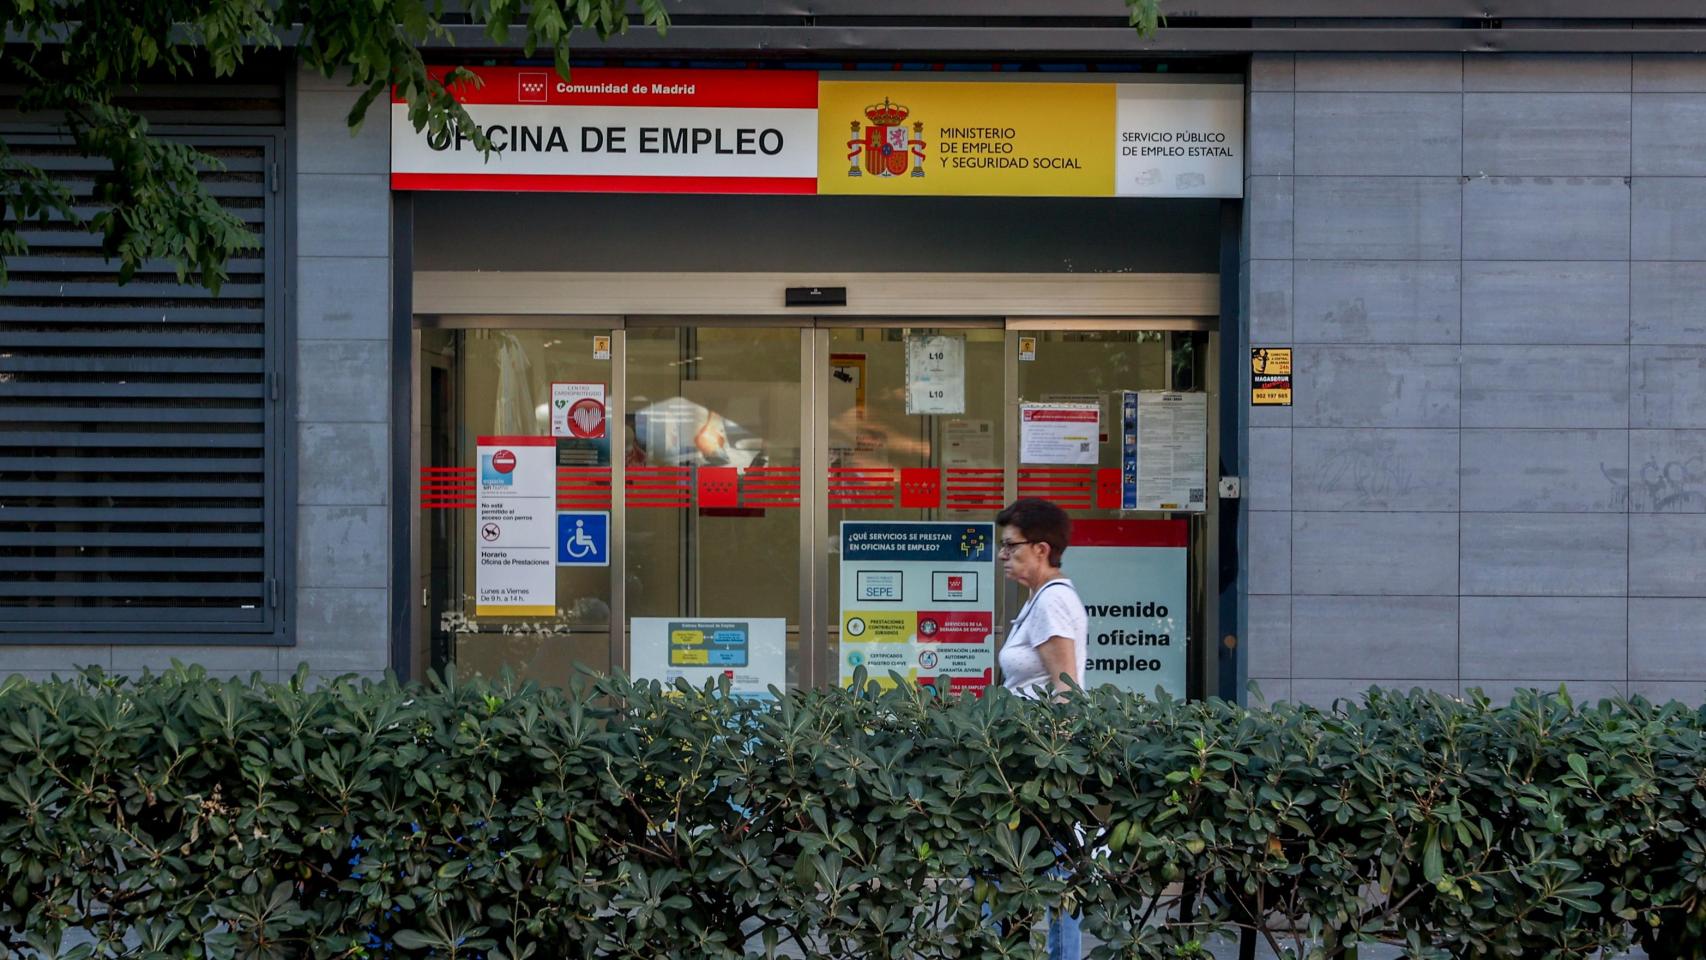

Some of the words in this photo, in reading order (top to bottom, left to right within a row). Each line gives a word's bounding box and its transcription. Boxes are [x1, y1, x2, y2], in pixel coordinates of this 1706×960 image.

[556, 82, 628, 94] Comunidad
[632, 84, 648, 94] de
[652, 84, 696, 95] Madrid
[940, 128, 1016, 139] MINISTERIO
[1122, 132, 1173, 142] SERVICIO
[1176, 130, 1226, 142] PÚBLICO
[426, 124, 568, 152] OFCINA
[581, 126, 626, 154] DE
[639, 127, 784, 156] EMPLEO
[940, 142, 958, 154] DE
[962, 142, 1014, 154] EMPLEO
[1122, 146, 1138, 156] DE
[1141, 146, 1185, 156] EMPLEO
[1188, 146, 1234, 157] ESTATAL
[940, 157, 949, 168] Y
[952, 157, 1029, 168] SEGURIDAD
[1033, 158, 1082, 169] SOCIAL
[849, 532, 867, 541] ¿QUÉ
[866, 587, 893, 596] SEPE
[1084, 602, 1168, 618] nvenido
[1098, 630, 1170, 646] oficina
[1085, 656, 1161, 674] empleo
